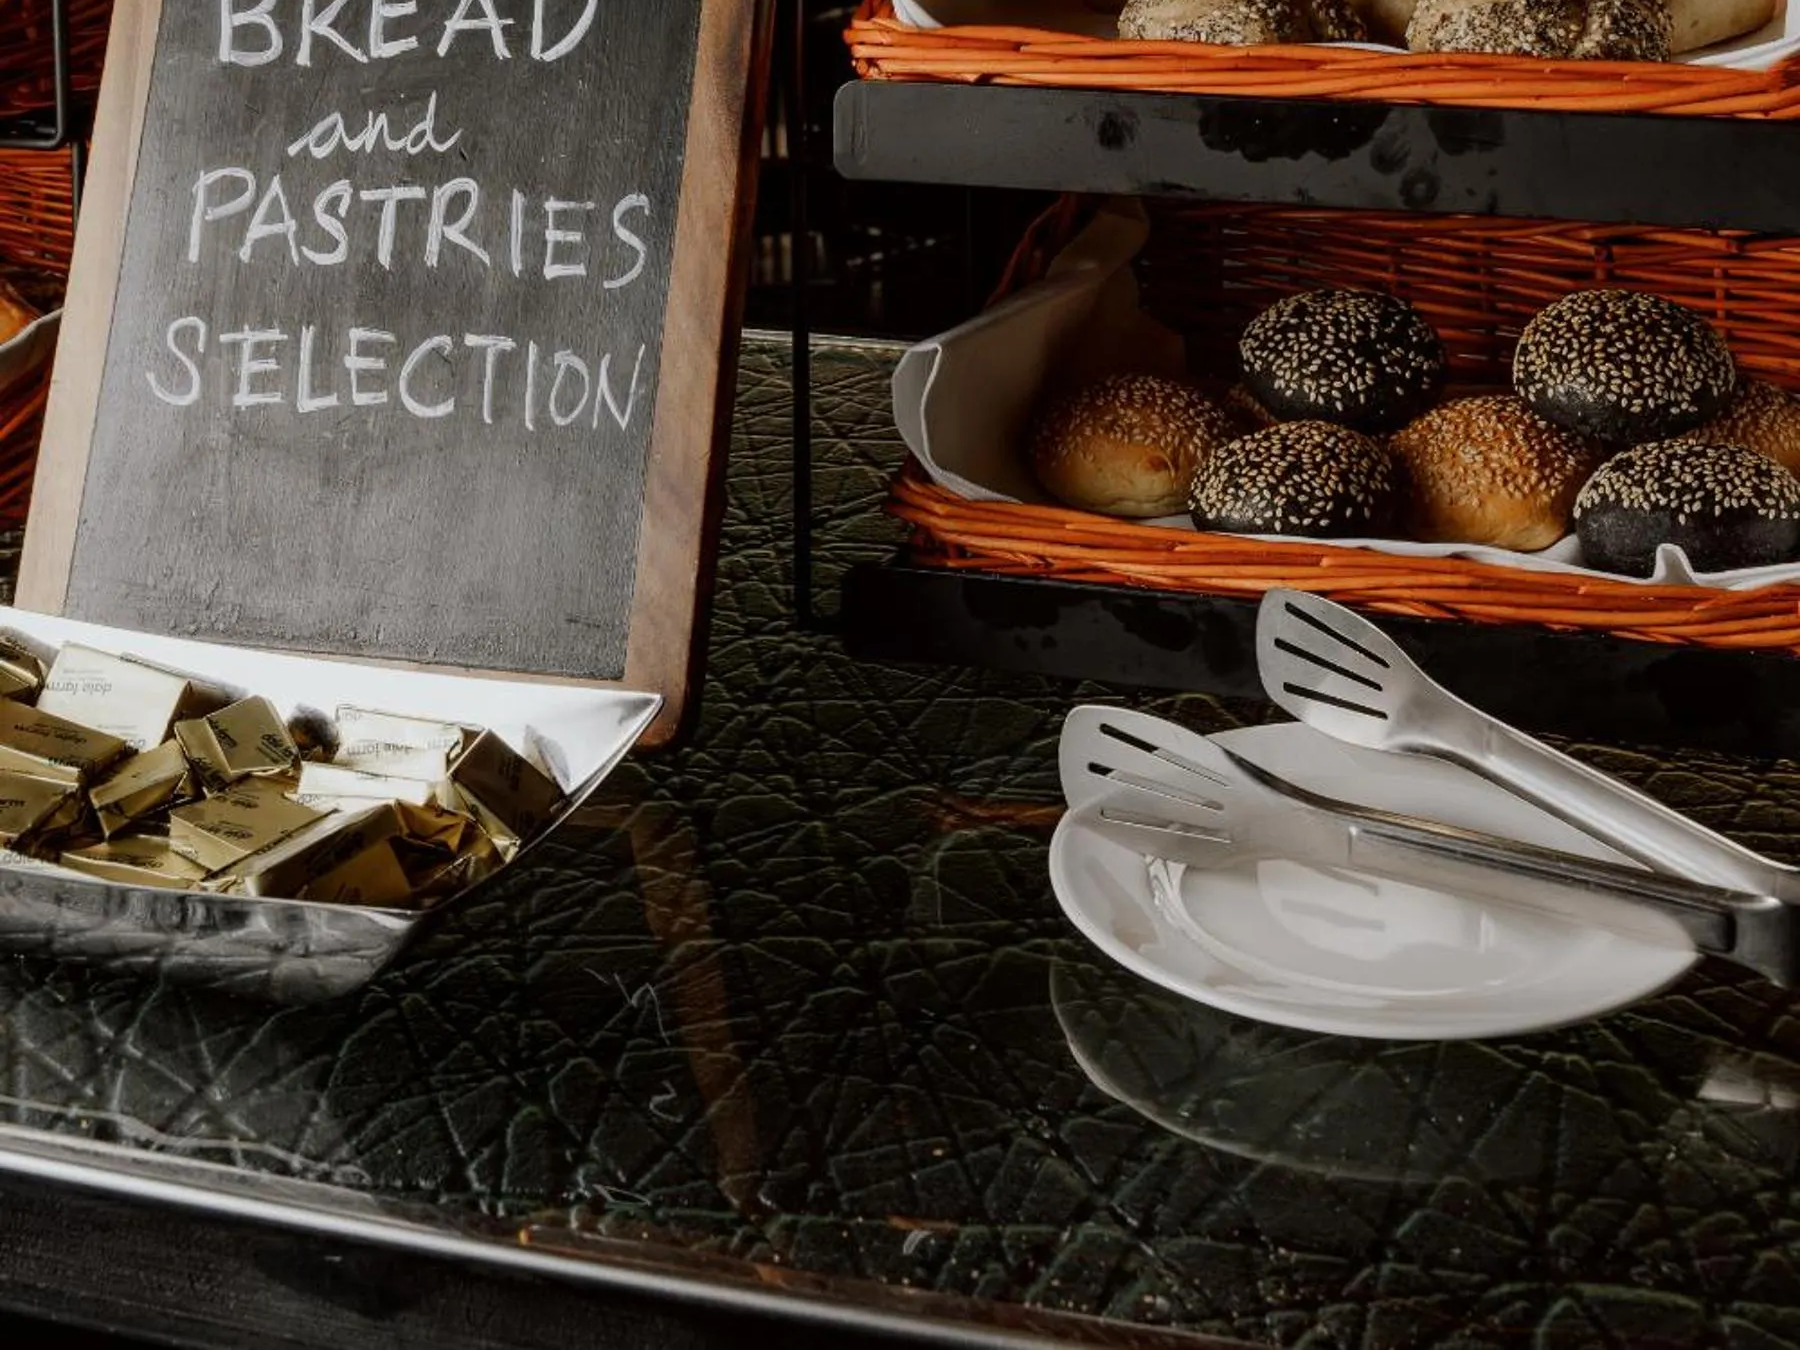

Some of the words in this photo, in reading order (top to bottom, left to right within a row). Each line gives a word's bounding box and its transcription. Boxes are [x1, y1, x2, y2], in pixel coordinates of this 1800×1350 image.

[288, 90, 462, 159] and
[188, 167, 650, 290] PASTRIES
[145, 316, 645, 431] SELECTION
